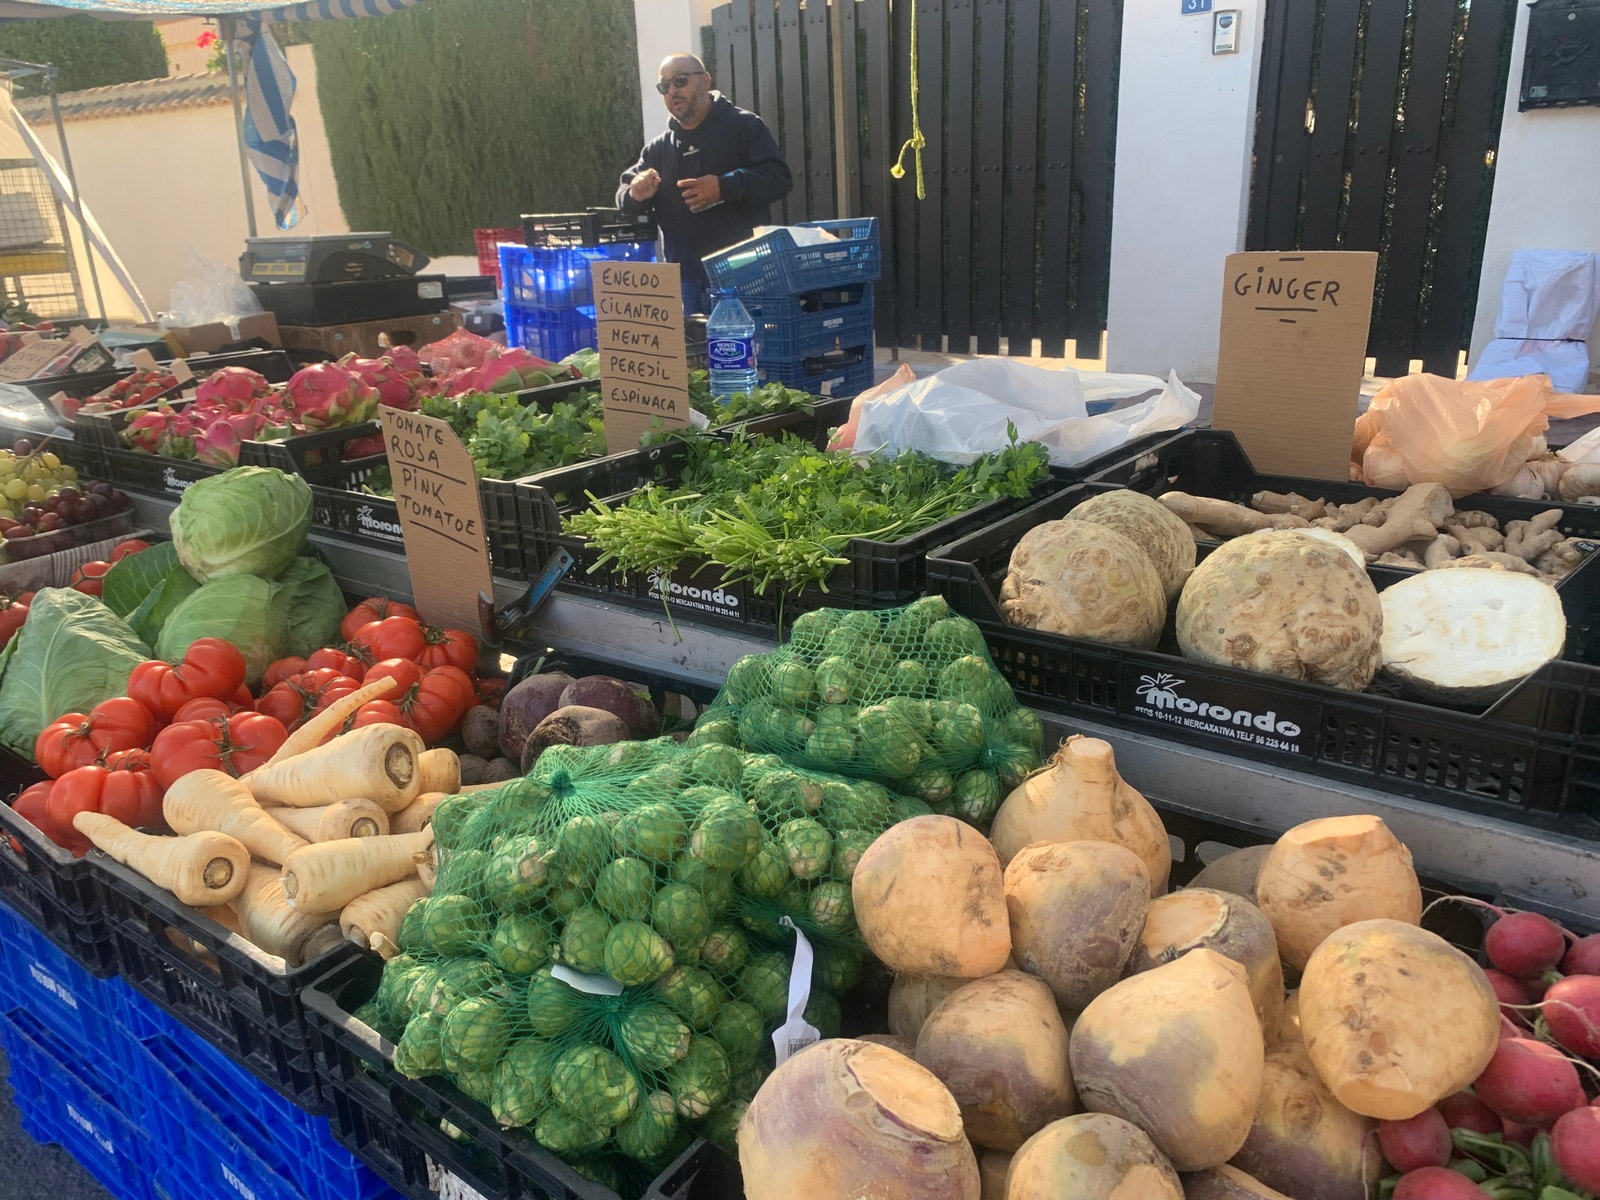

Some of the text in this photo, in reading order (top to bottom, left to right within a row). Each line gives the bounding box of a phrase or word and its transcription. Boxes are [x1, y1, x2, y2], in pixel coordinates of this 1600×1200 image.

[602, 268, 660, 288] ENELDO
[612, 329, 659, 350] MENTA
[386, 411, 443, 445] TOMATE
[391, 435, 439, 469] ROSA
[401, 494, 476, 536] TOMATOE
[1146, 688, 1301, 737] morondo
[1154, 711, 1182, 725] 10-11-12
[1183, 717, 1235, 739] MERCAXATIVA
[1236, 730, 1255, 742] TELF
[1265, 737, 1279, 749] 225
